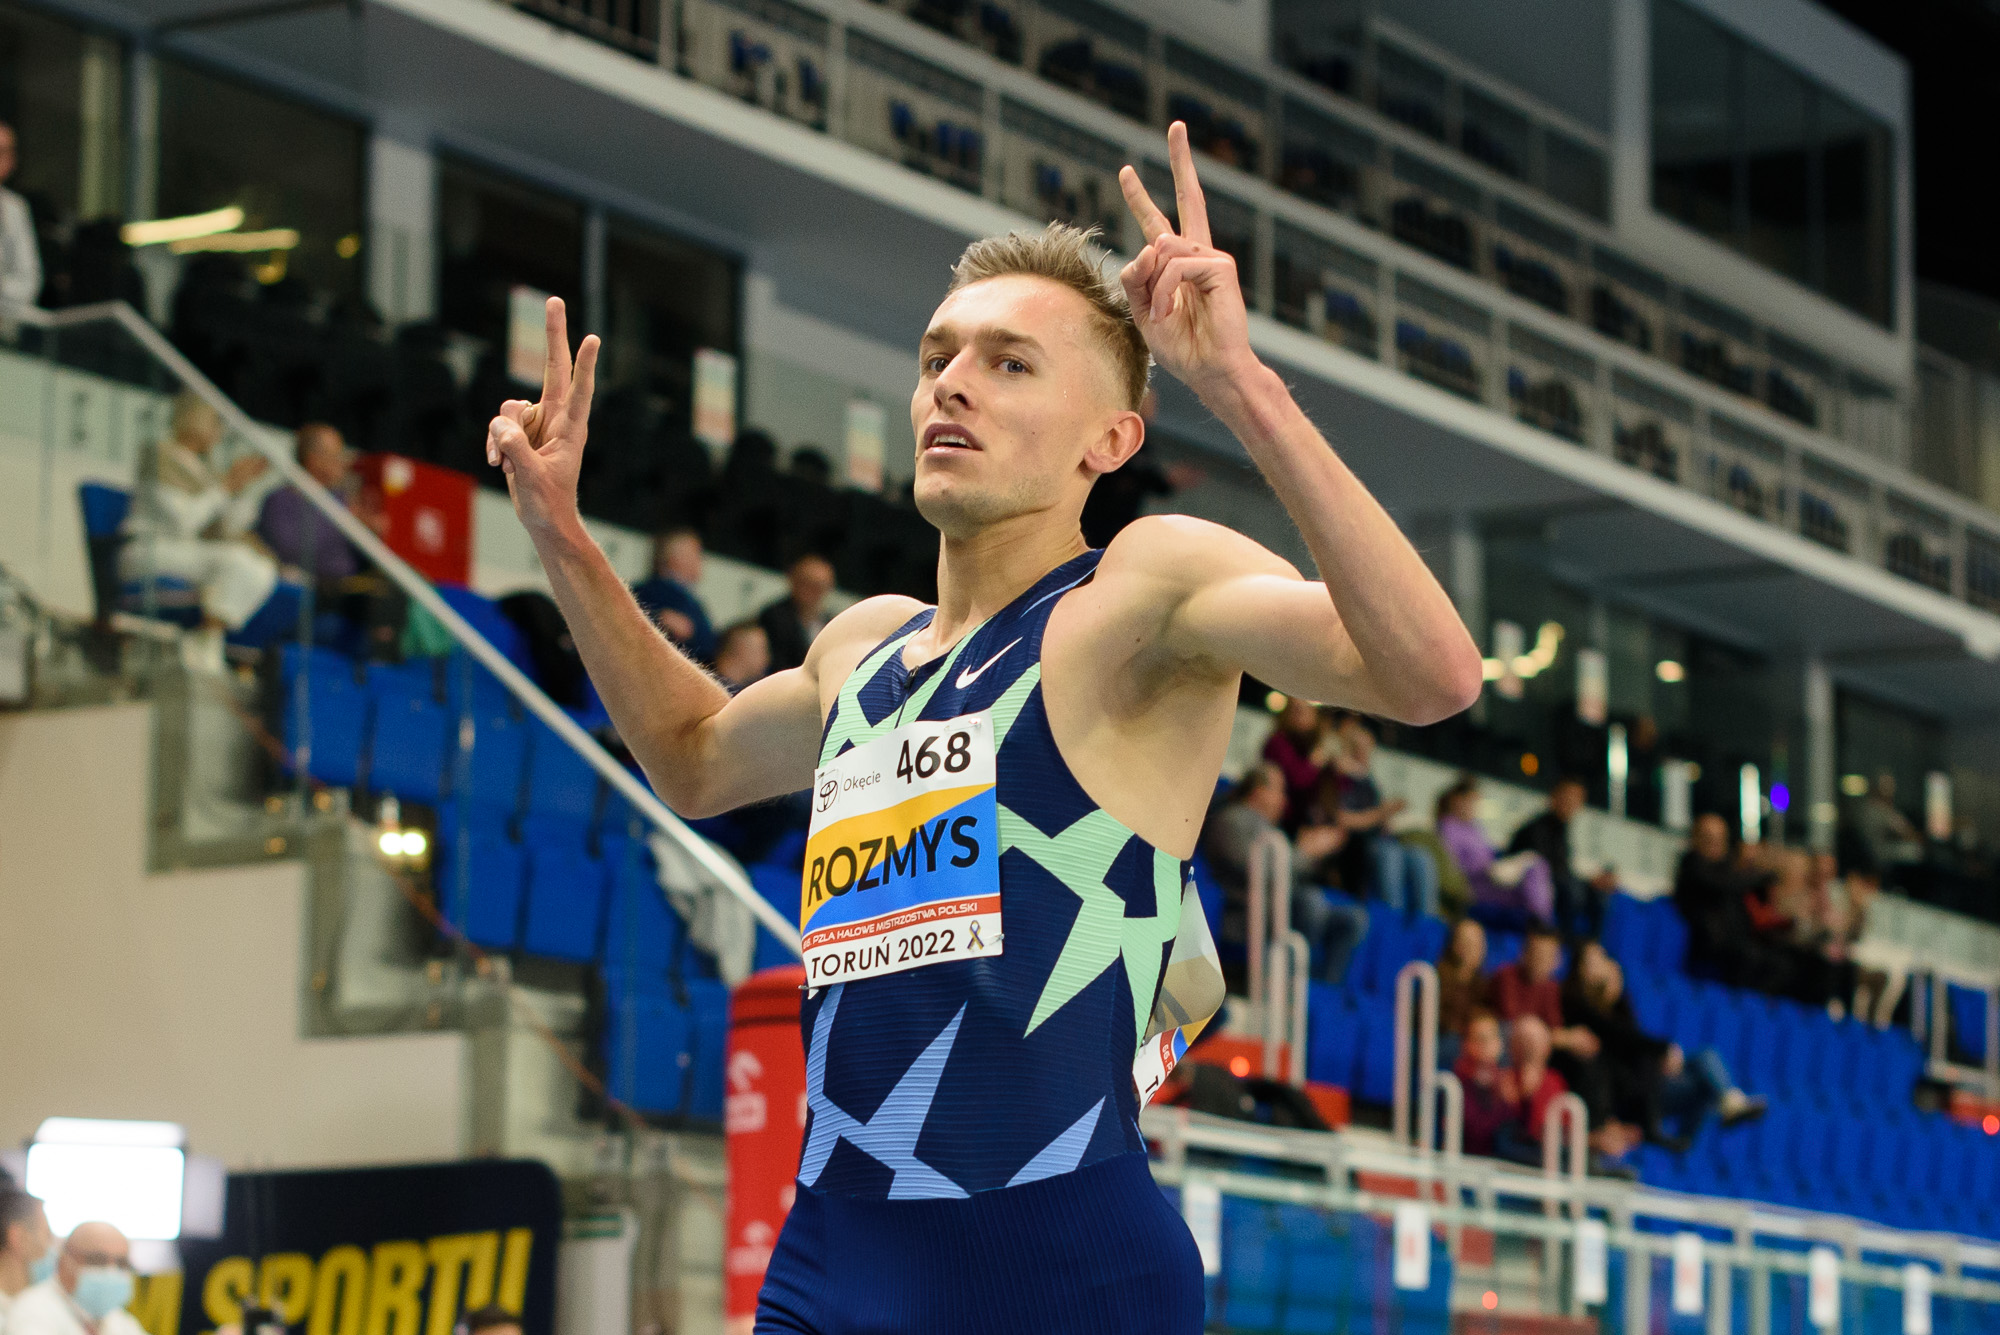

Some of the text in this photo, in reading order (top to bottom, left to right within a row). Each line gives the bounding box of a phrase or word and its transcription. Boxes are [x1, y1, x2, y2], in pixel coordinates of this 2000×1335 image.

[843, 771, 881, 791] Okęcie
[896, 731, 971, 785] 468
[807, 815, 980, 907] ROZMYS
[813, 931, 835, 944] PZLA
[837, 924, 874, 939] HALOWE
[876, 909, 936, 931] MISTRZOSTWA
[938, 903, 977, 916] POLSKI
[812, 930, 955, 979] TORUŃ 2022
